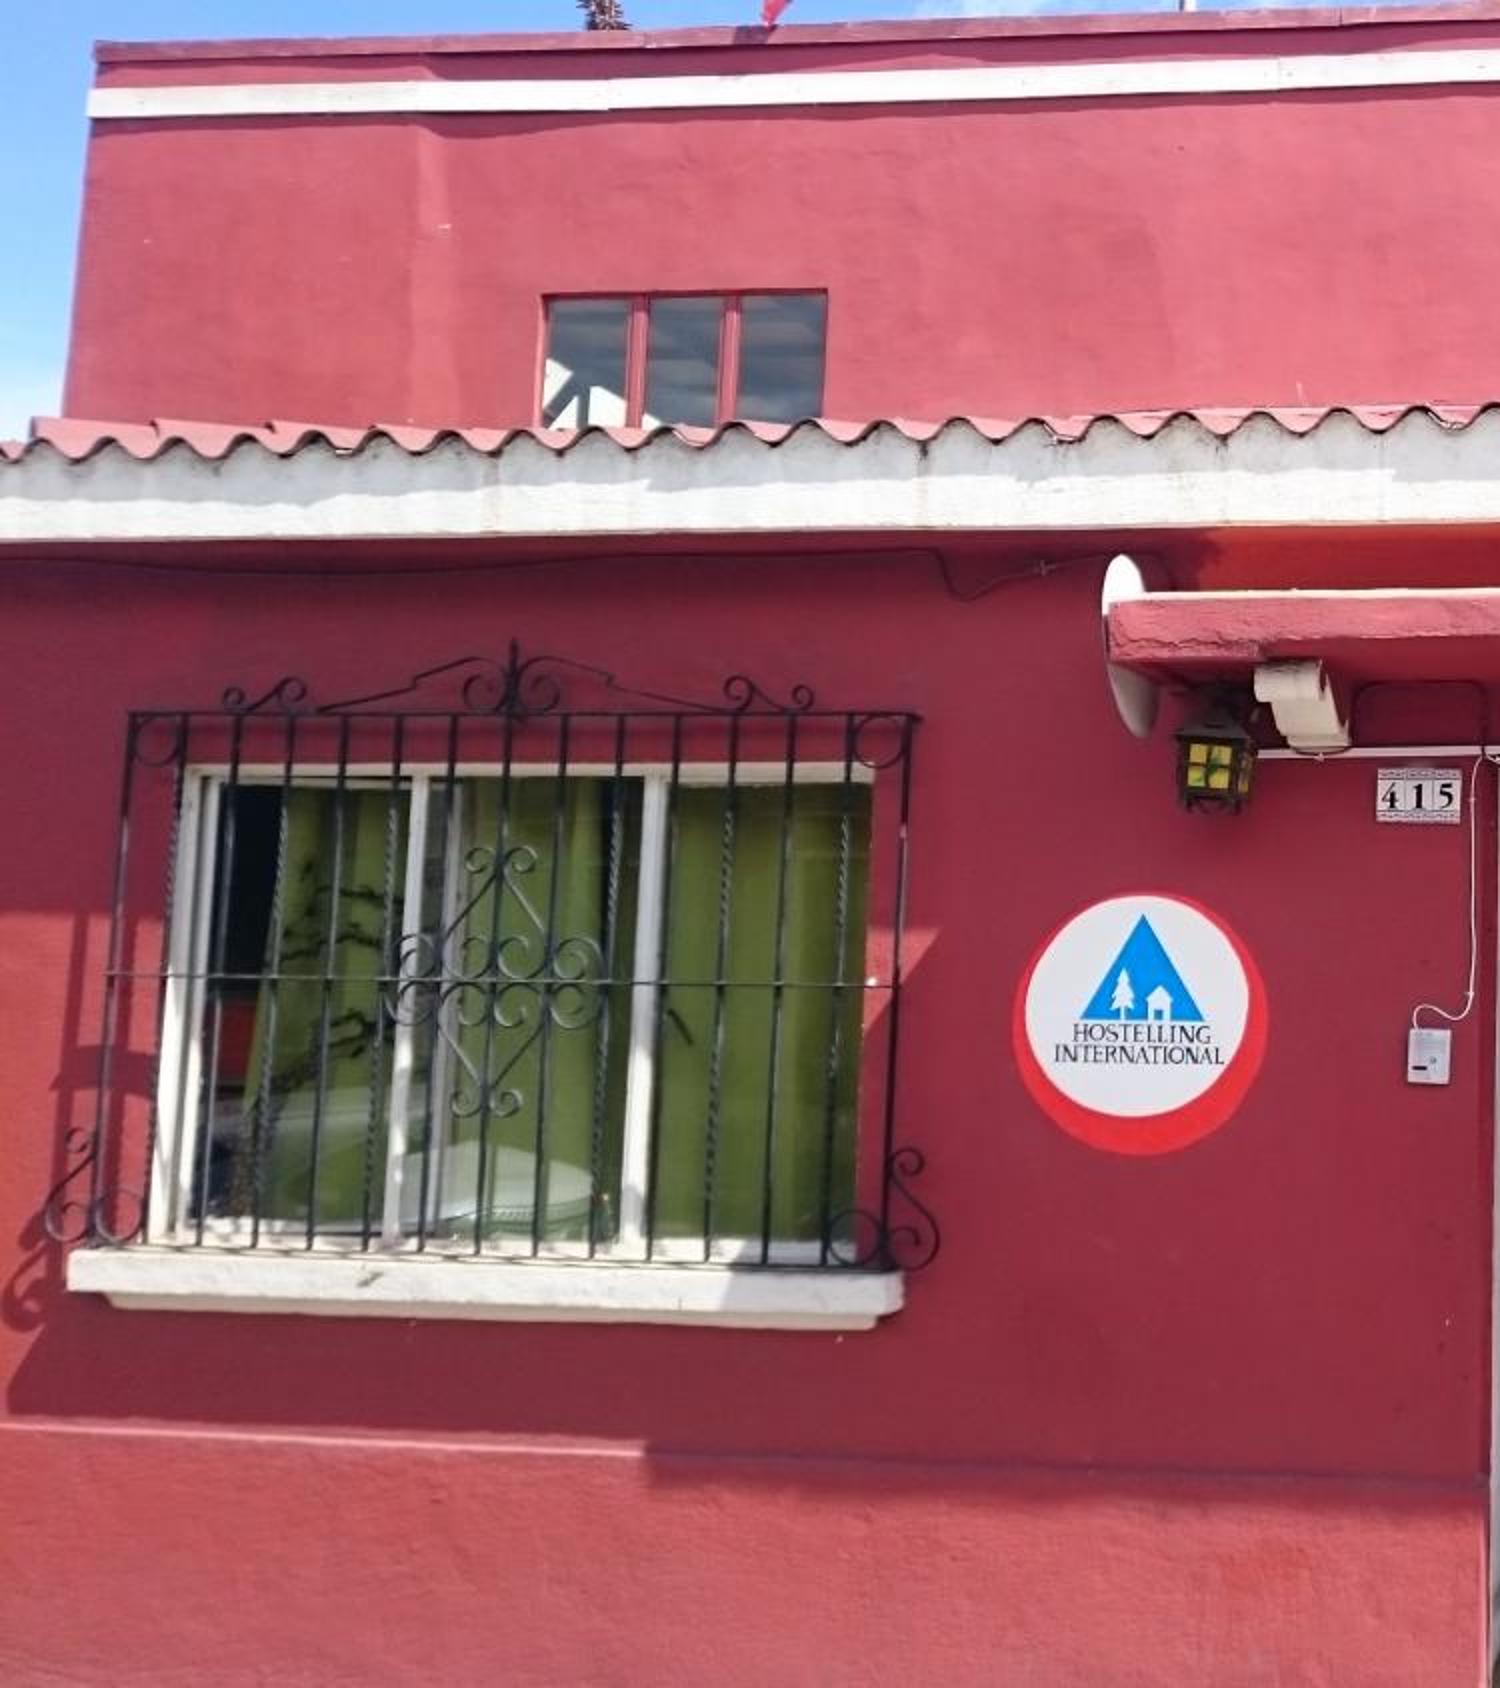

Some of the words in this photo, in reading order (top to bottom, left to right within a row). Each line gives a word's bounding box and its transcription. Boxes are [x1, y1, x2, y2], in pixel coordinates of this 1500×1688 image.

[1381, 781, 1454, 809] 415
[1072, 1023, 1212, 1044] HOSTELLING
[1054, 1043, 1225, 1065] INTERNATIONAL
